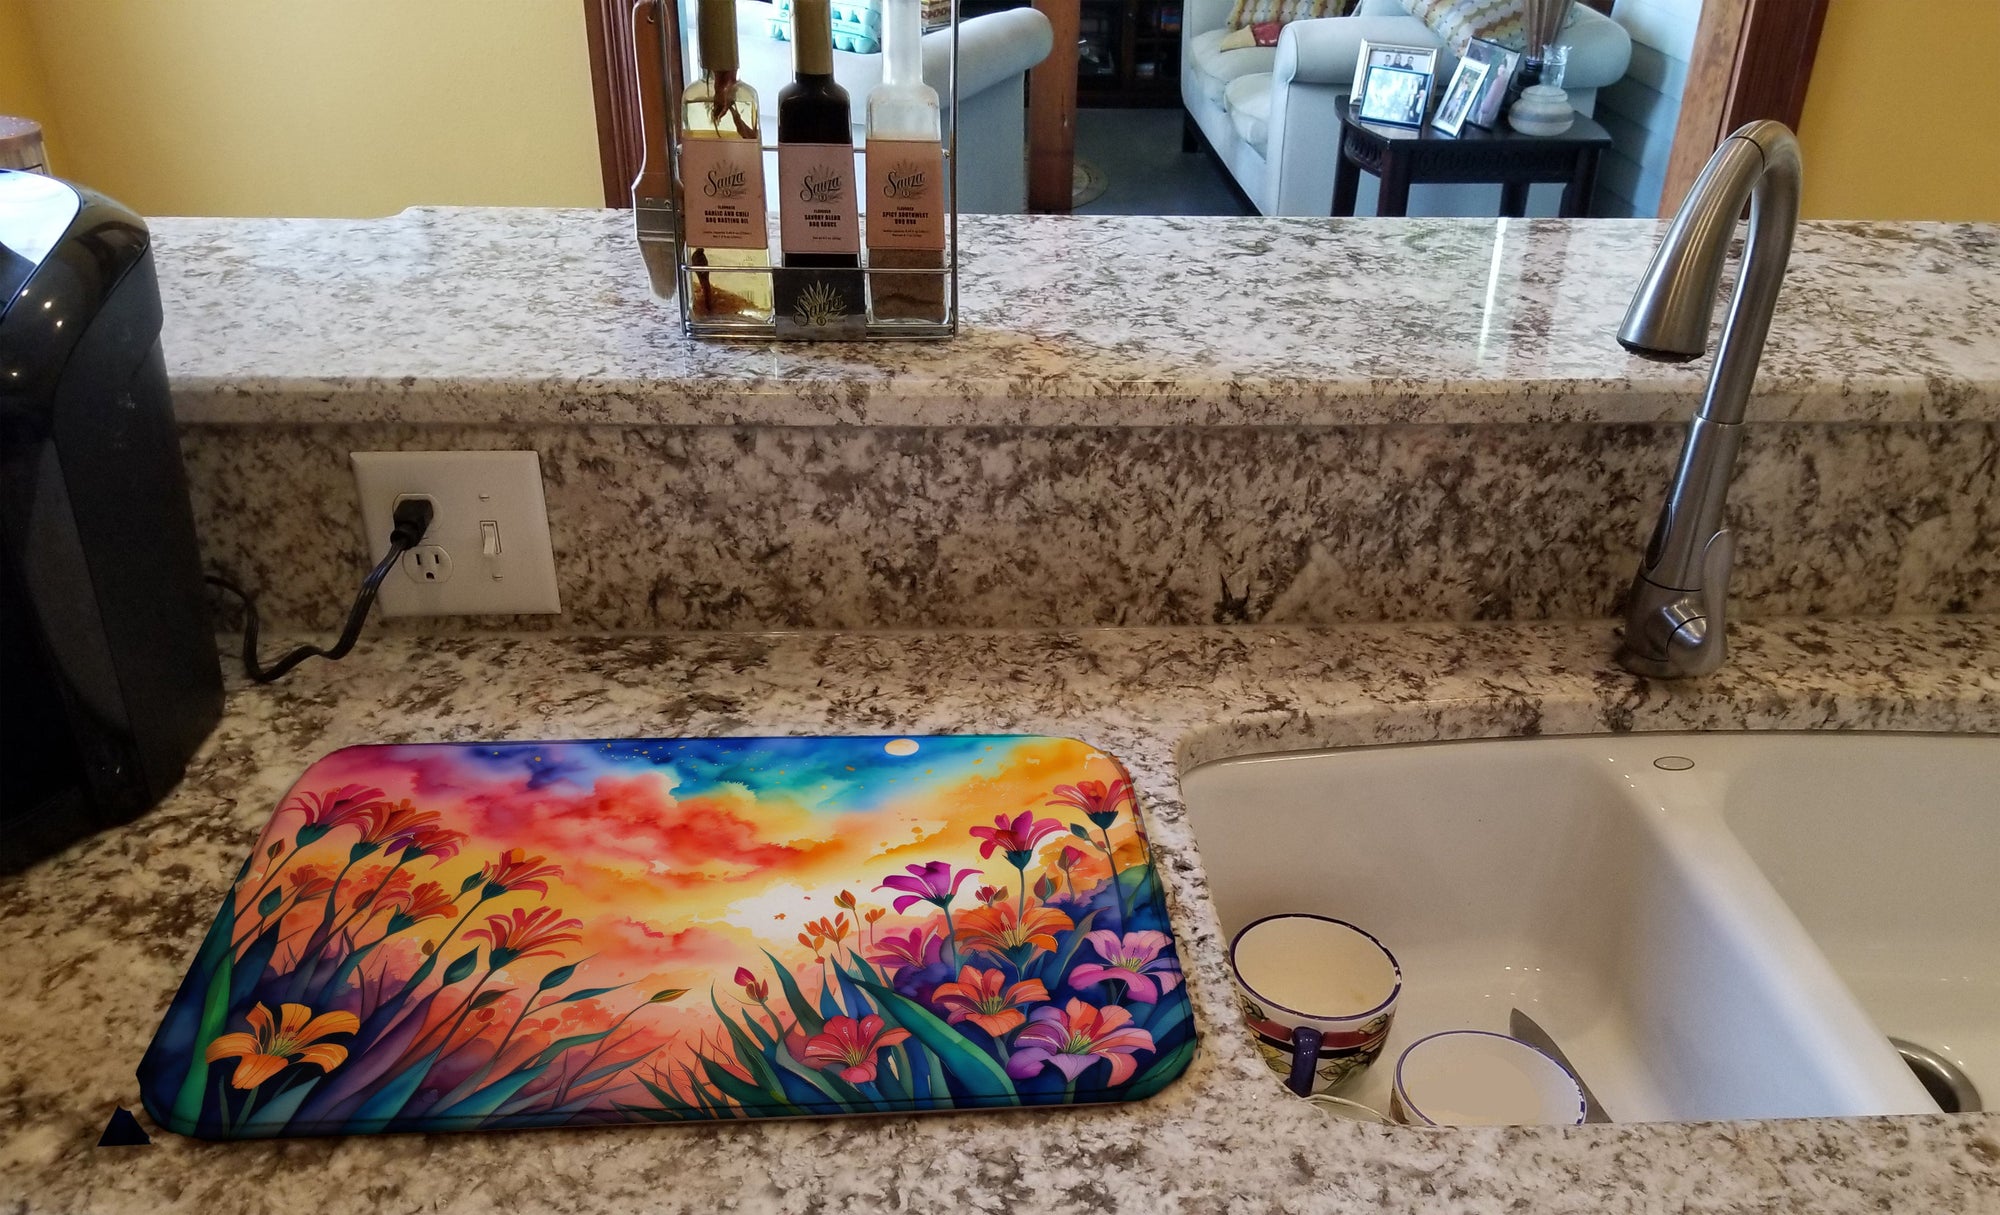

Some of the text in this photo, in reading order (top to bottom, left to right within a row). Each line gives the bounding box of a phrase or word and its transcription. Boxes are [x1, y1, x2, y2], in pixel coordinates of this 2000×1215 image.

[704, 170, 746, 197] Sauza
[800, 175, 841, 202] Sauza
[884, 171, 925, 198] Sauza
